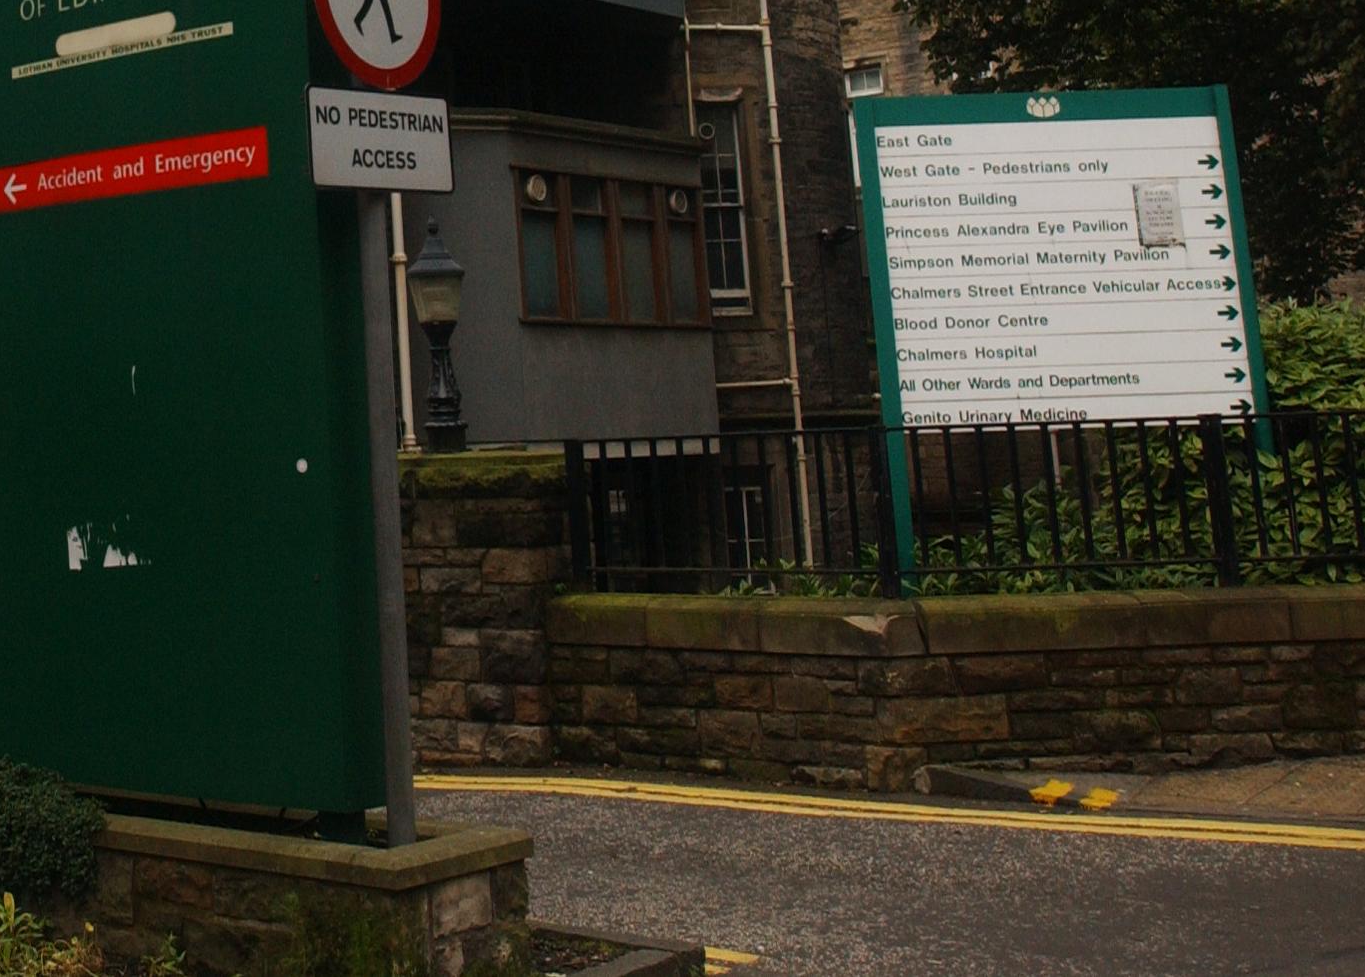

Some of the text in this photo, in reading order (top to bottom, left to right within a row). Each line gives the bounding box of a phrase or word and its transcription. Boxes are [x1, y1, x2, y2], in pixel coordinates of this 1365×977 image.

[56, 50, 107, 68] UNIVERSITY
[111, 39, 162, 55] HOSPITALS
[166, 34, 186, 44] NHS
[191, 26, 223, 39] TRUST
[315, 105, 444, 134] NO PEDESTRIAN
[877, 134, 952, 148] East Gate
[37, 144, 256, 191] Accident and Emergency
[352, 148, 416, 170] ACCESS
[881, 164, 917, 178] West
[925, 163, 960, 177] Gate
[983, 161, 1069, 175] Pedestrians
[1079, 160, 1109, 174] only
[883, 192, 1017, 208] Lauriston Building
[886, 219, 1128, 239] Princess Alexandra Eye Pavilion
[889, 248, 1169, 272] Simpson Memorial Maternity Pavilion
[891, 277, 1221, 300] Chalmers Street Entrance Vehicular Access
[894, 314, 1048, 331] Blood Donor Centre
[897, 345, 1037, 362] Chalmers Hospital
[900, 372, 1139, 393] All Other Wards and Departments
[902, 407, 1087, 424] Genito Urinary Medicine
